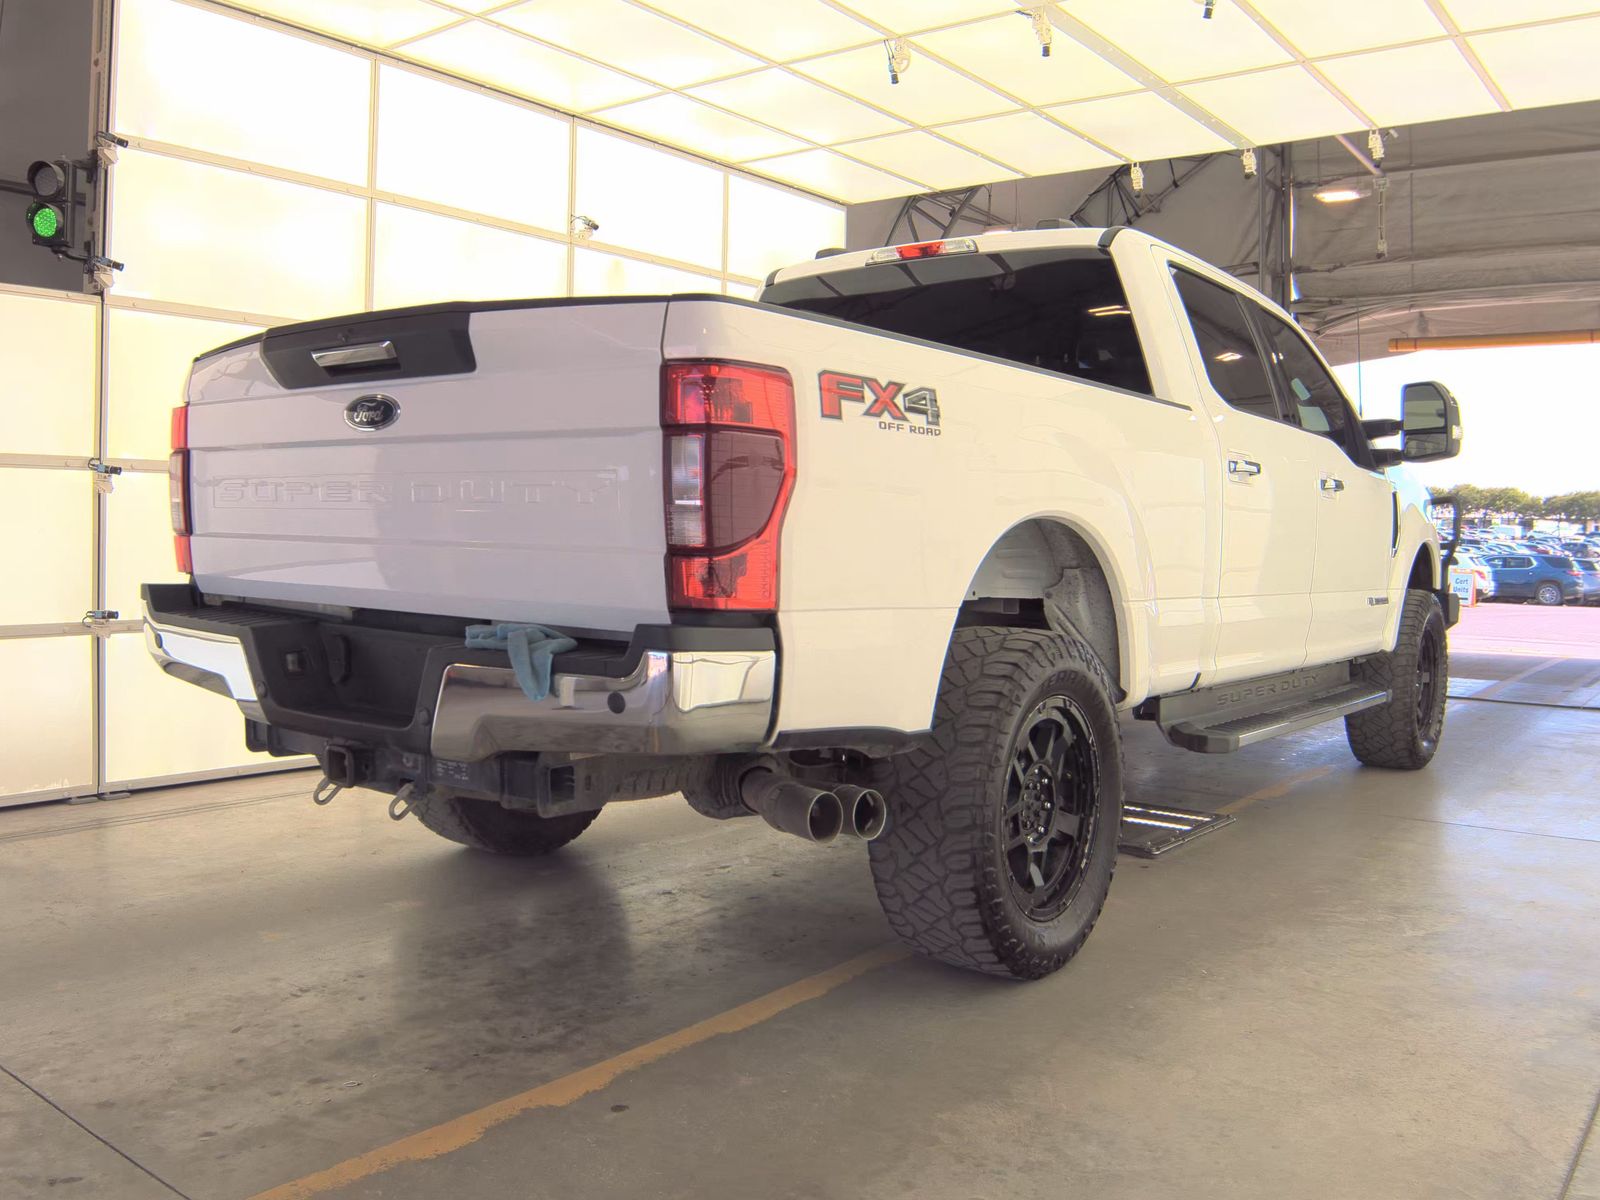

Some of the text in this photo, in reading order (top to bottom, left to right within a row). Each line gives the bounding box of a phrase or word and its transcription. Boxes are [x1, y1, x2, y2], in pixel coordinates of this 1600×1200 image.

[818, 370, 942, 426] FX4
[353, 401, 385, 422] Ford
[878, 421, 942, 437] OFF ROAD
[217, 479, 611, 504] SUPER DUTY
[1216, 673, 1320, 706] SUPER DUTY
